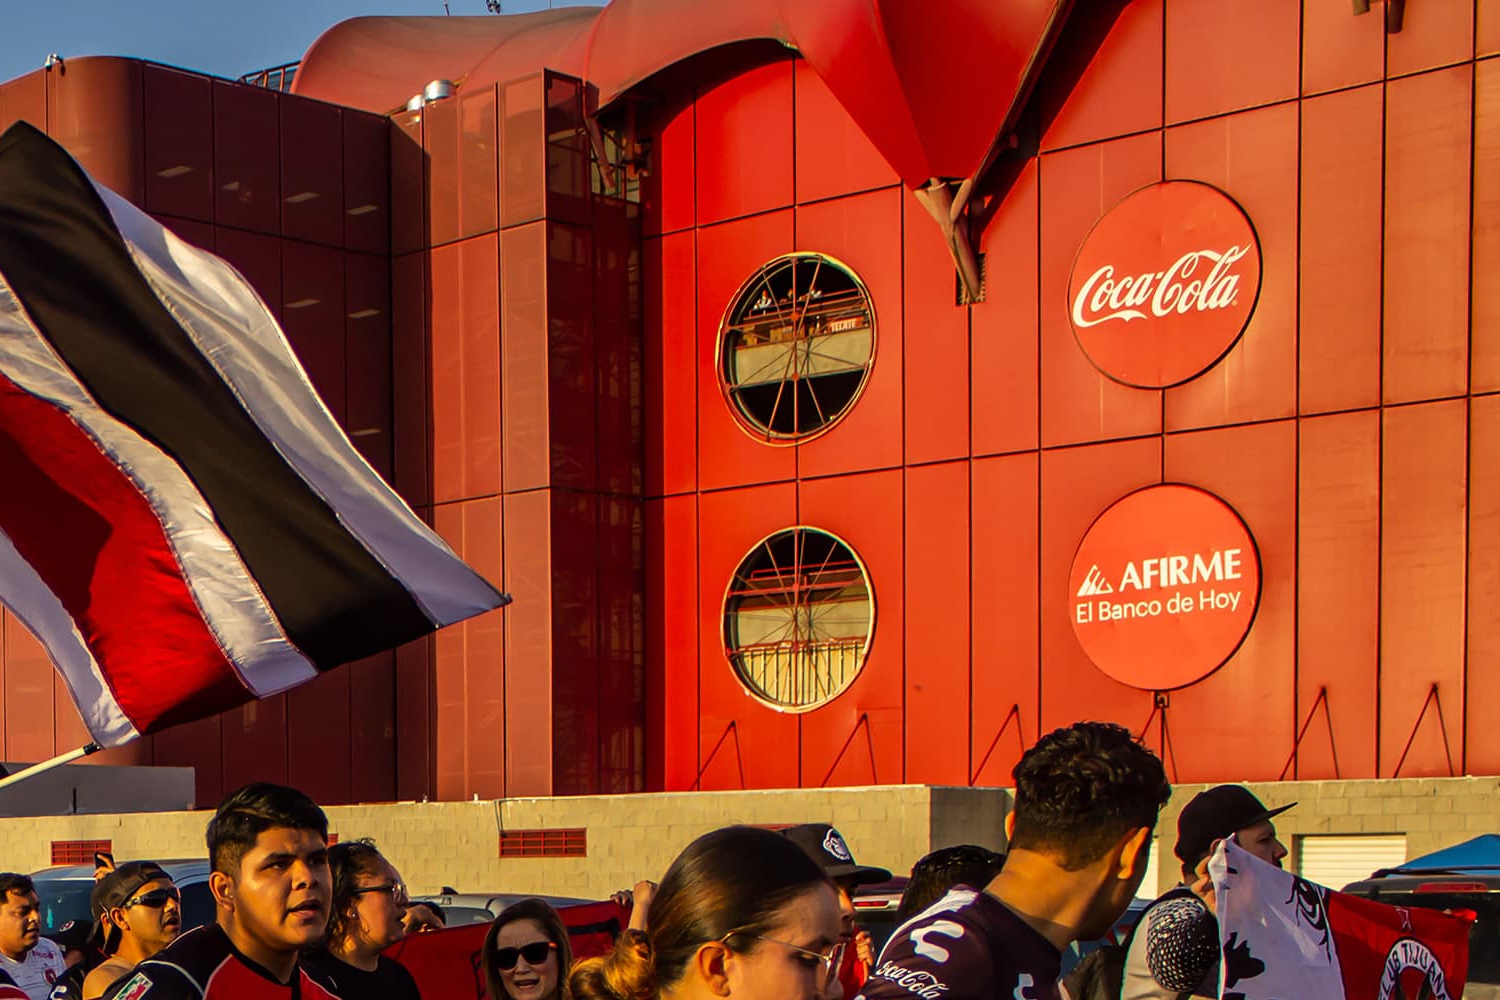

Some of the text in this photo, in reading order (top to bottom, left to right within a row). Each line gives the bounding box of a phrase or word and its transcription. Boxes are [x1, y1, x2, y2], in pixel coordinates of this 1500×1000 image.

[1072, 243, 1252, 328] Coca-Cola
[1118, 548, 1242, 592] AFIRME
[1076, 588, 1242, 624] El Banco de Hoy
[870, 959, 950, 1000] oca-Cola
